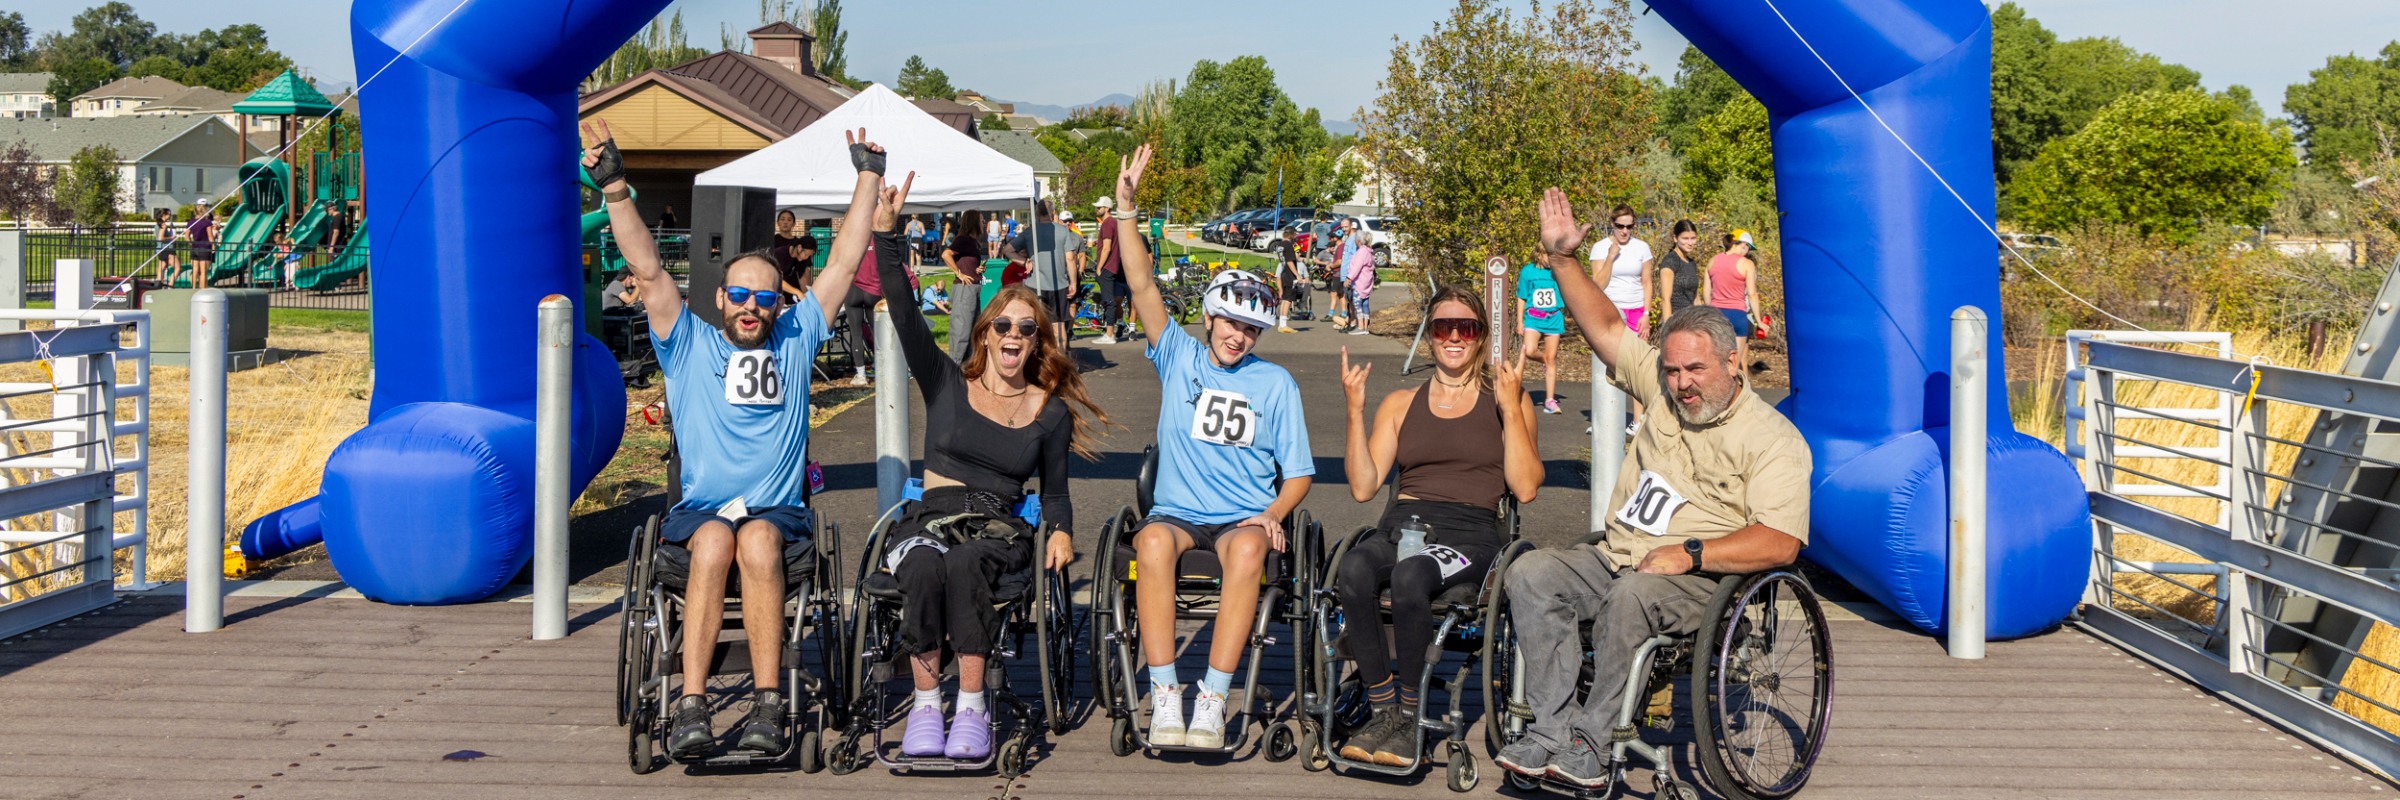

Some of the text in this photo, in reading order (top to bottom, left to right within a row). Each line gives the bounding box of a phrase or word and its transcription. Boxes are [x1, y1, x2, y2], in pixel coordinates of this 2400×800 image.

[1537, 291, 1553, 306] 33
[736, 355, 778, 399] 36
[1202, 395, 1248, 441] 55
[1626, 477, 1671, 526] 90
